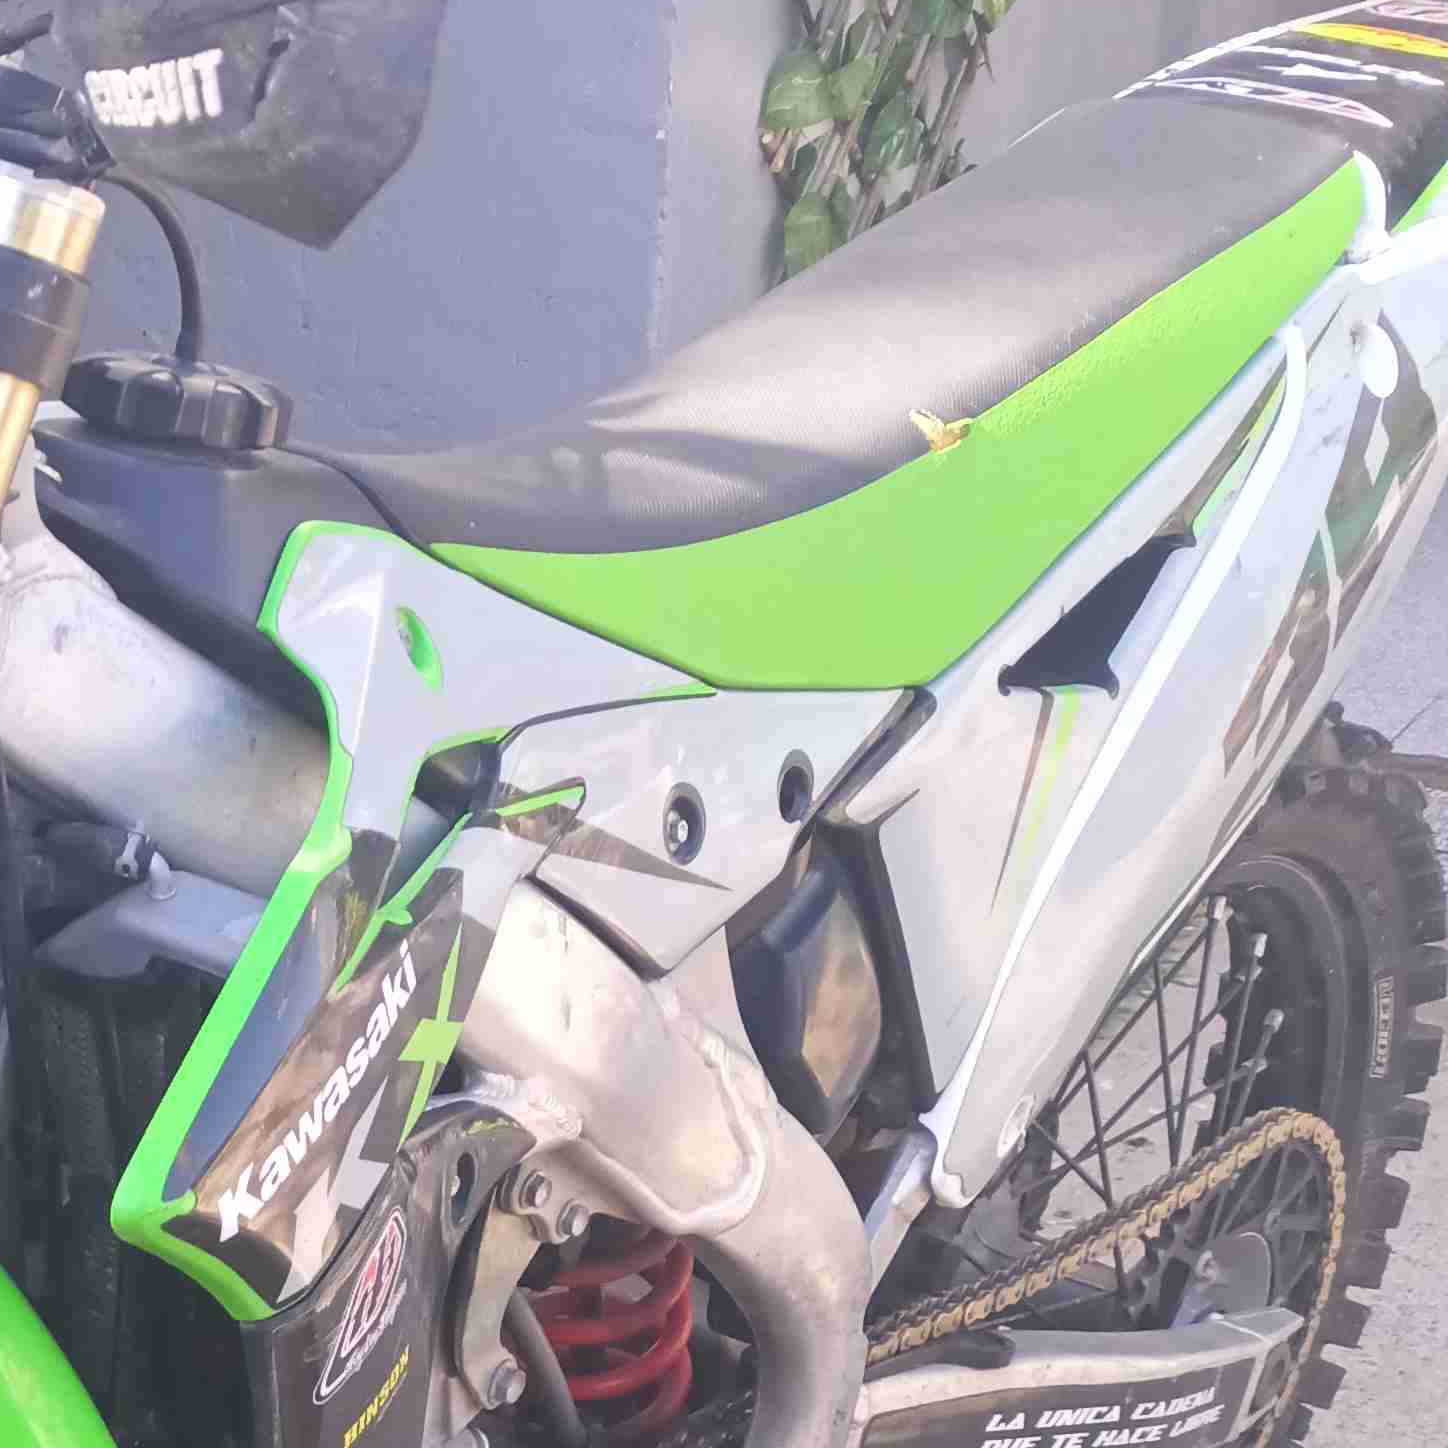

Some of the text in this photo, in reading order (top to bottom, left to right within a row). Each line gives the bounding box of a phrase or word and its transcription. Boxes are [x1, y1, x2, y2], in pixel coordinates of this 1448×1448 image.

[219, 938, 417, 1243] Kawasaki
[985, 1413, 1025, 1432] LA
[1035, 1405, 1121, 1429] UNICA
[1092, 1424, 1169, 1448] HACE
[1169, 1404, 1225, 1438] LIBRE
